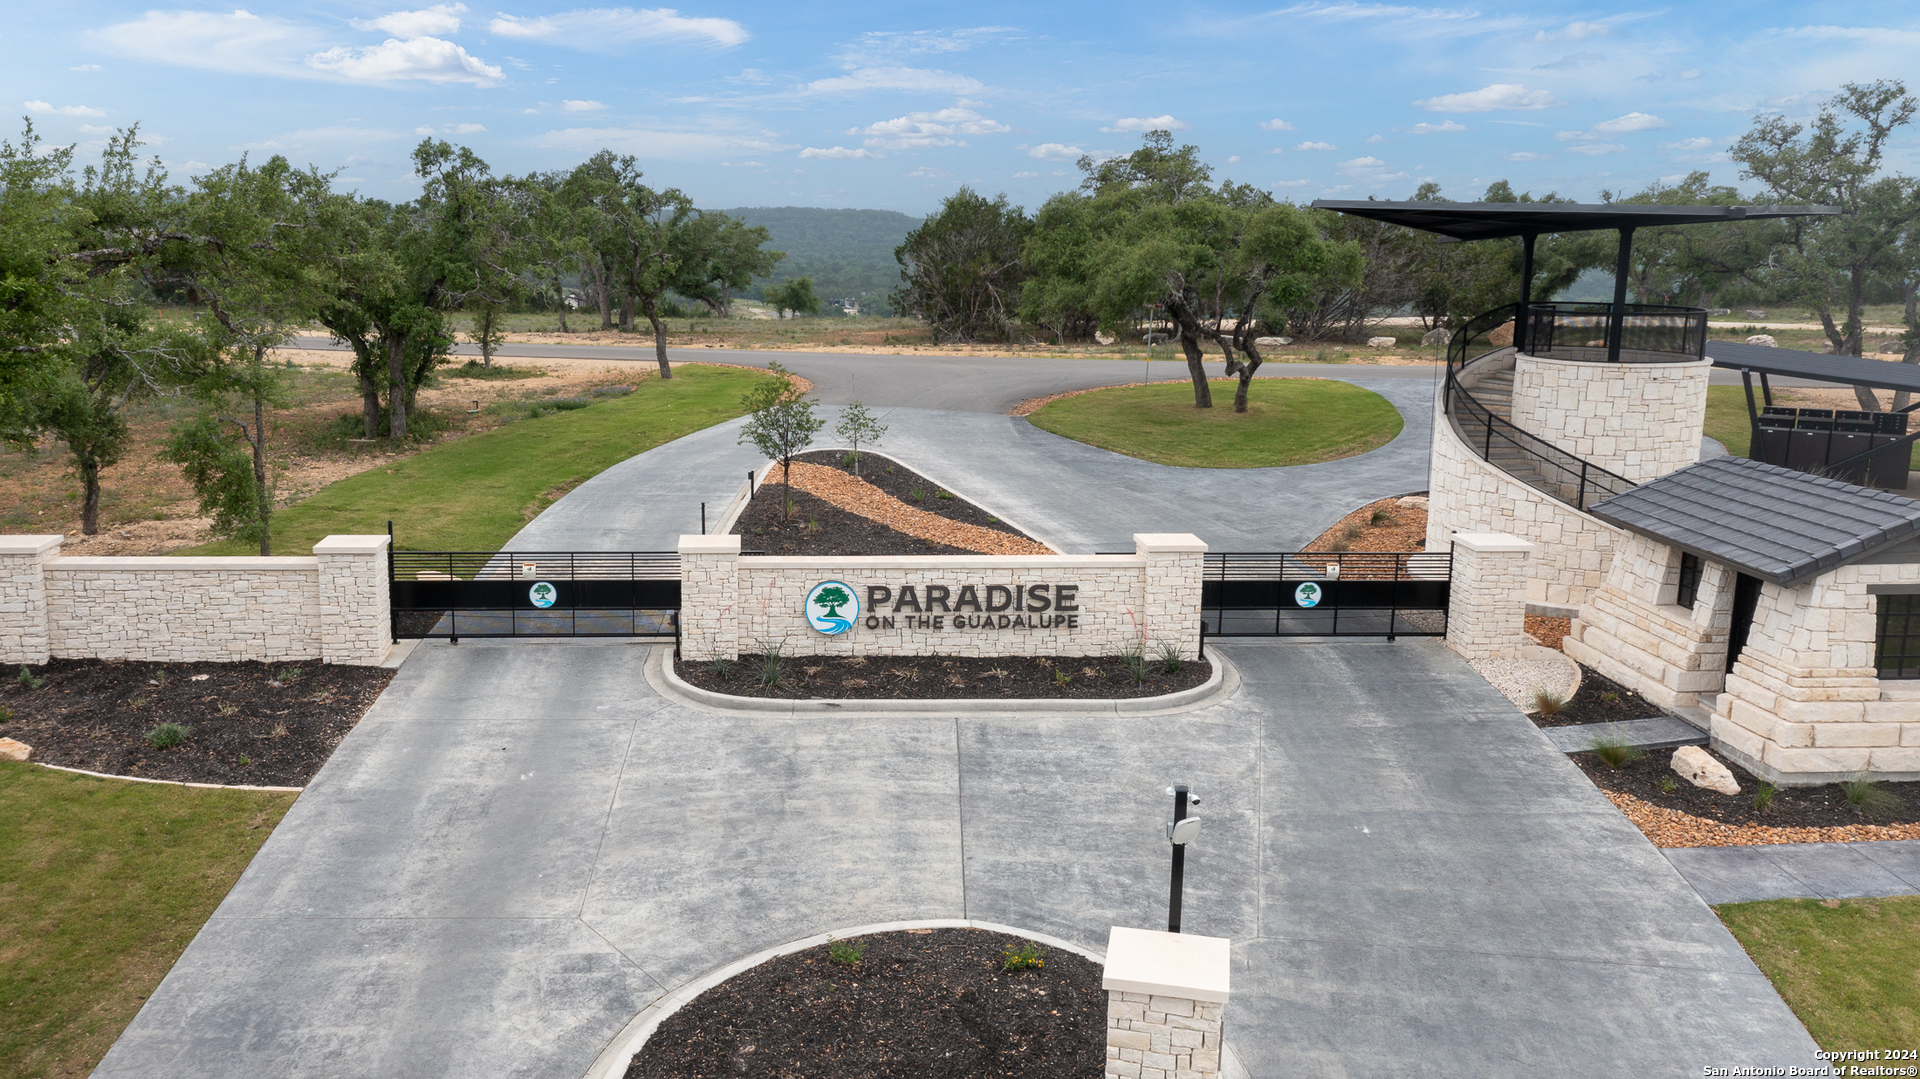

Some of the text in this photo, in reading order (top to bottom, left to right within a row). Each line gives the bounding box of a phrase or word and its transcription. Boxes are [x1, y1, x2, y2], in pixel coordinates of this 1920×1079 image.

[866, 584, 1079, 612] PARADISE
[865, 614, 1079, 630] ON THE GUADALUPE
